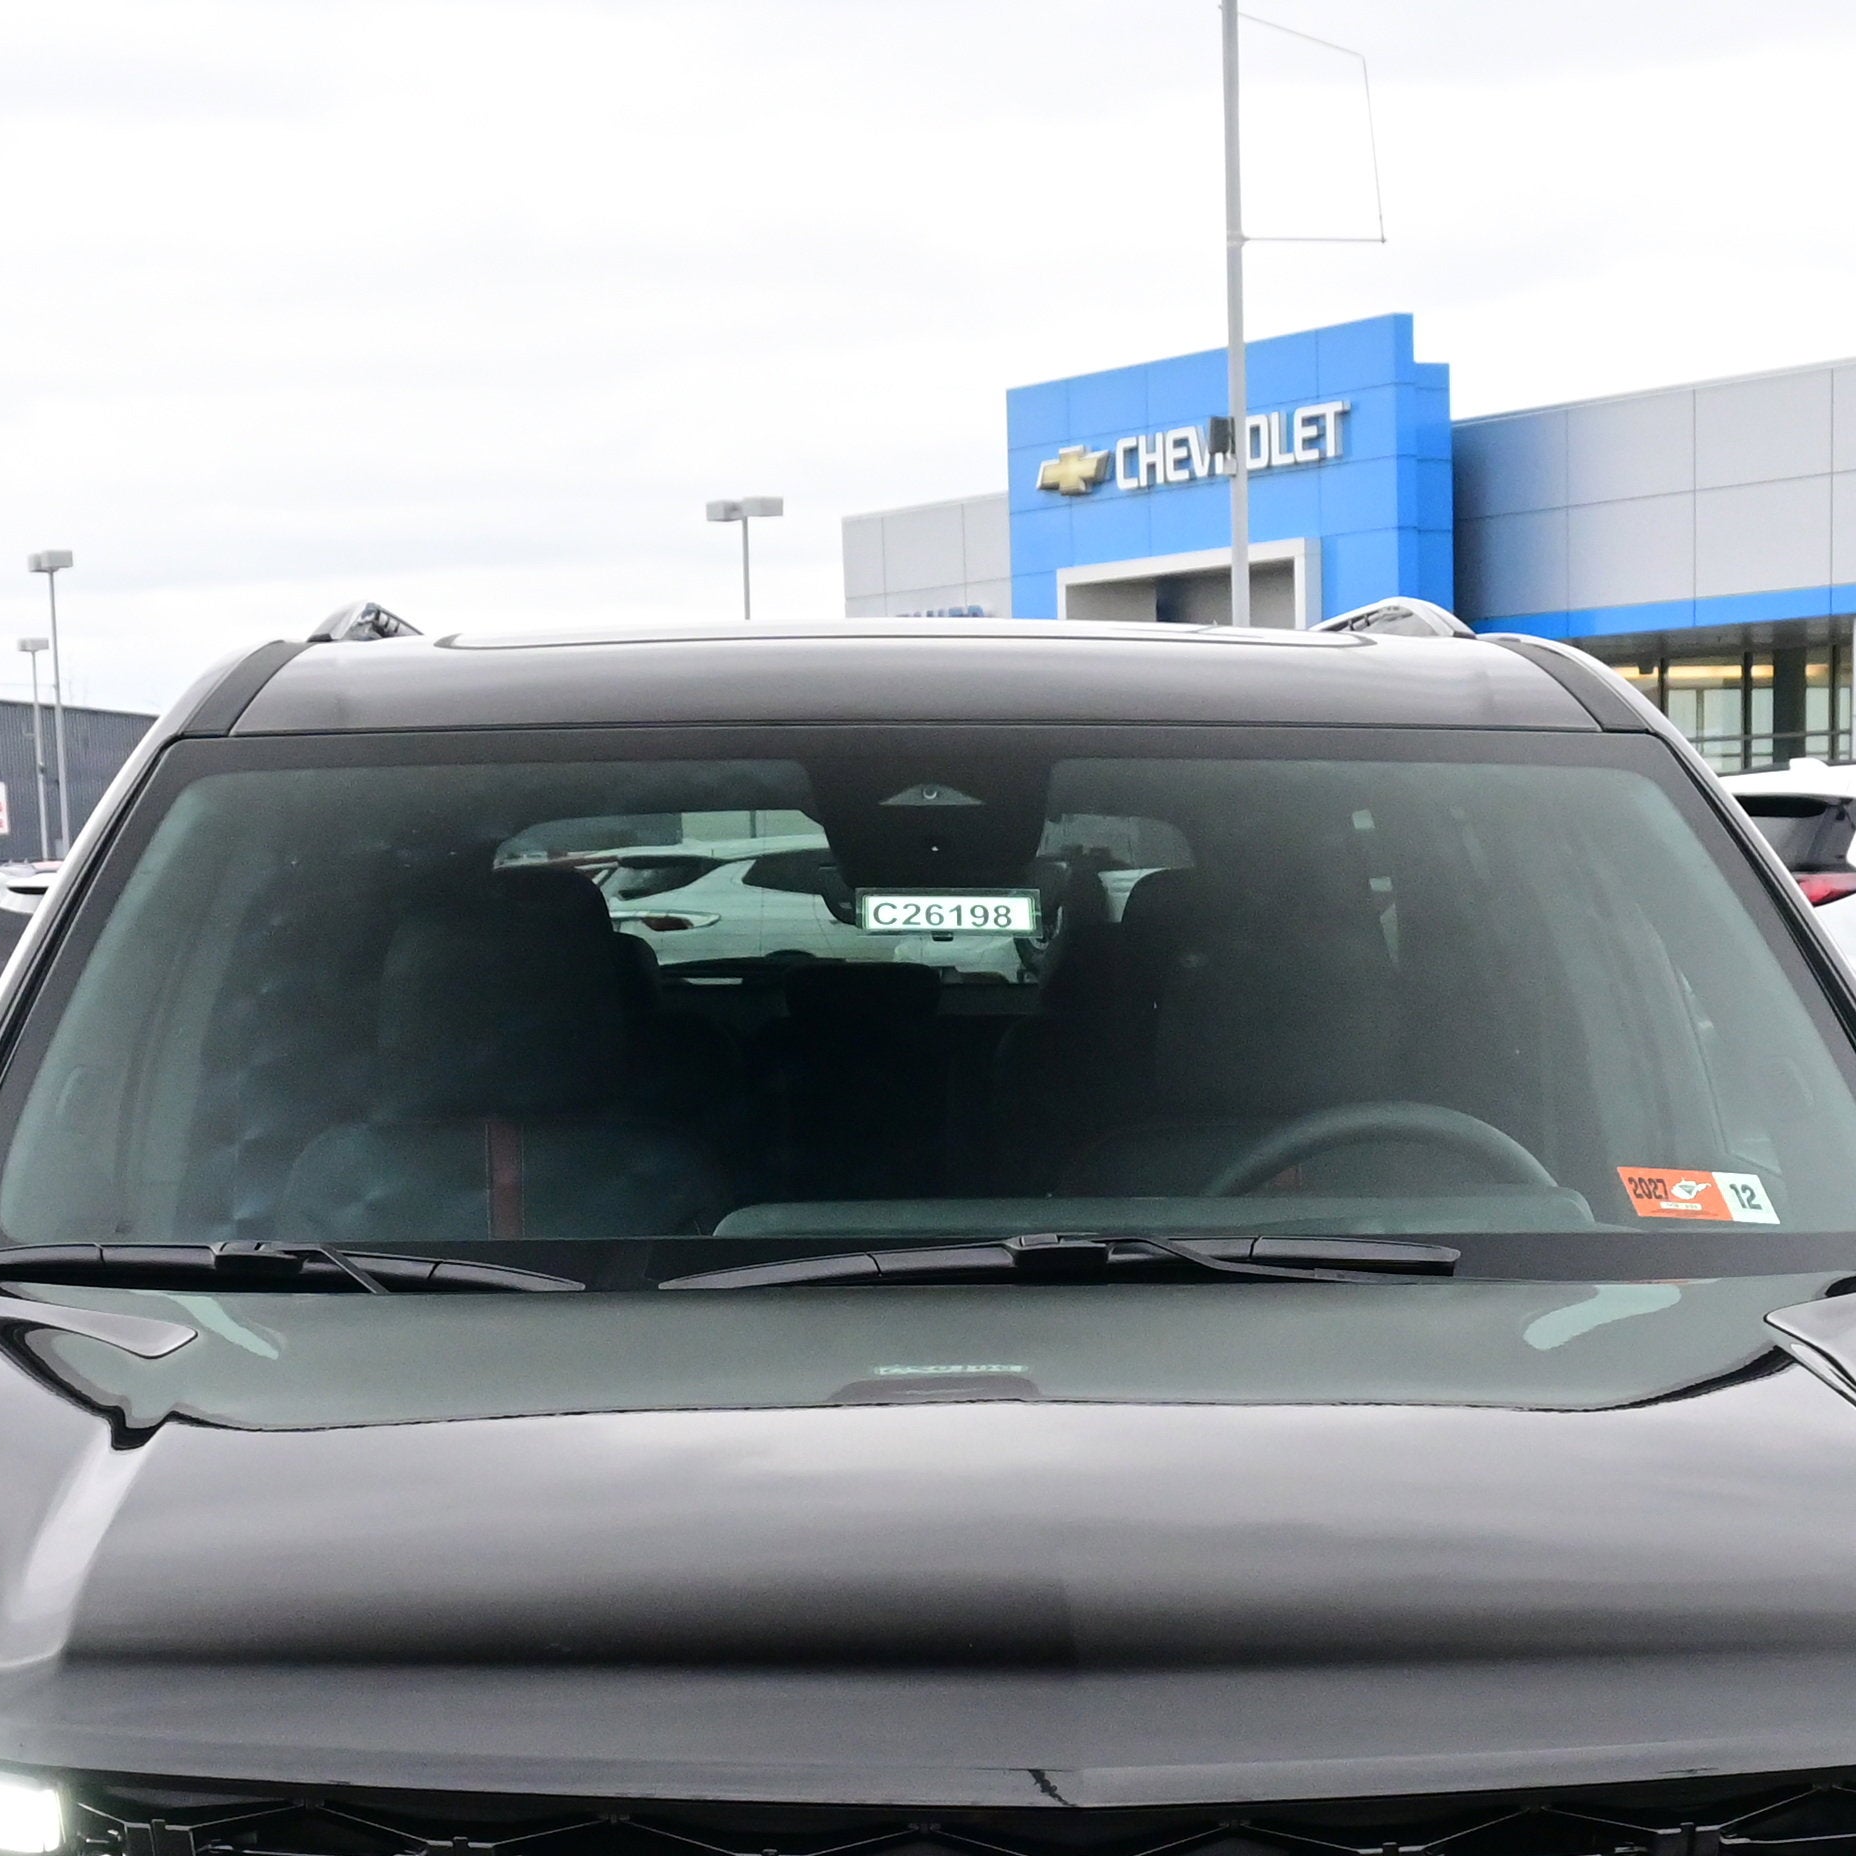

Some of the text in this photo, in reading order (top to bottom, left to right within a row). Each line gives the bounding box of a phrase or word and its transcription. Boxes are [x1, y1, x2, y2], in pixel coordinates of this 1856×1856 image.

[1115, 400, 1351, 491] CHEVOLET
[872, 902, 1013, 928] C26198
[1627, 1176, 1763, 1211] 2027 12
